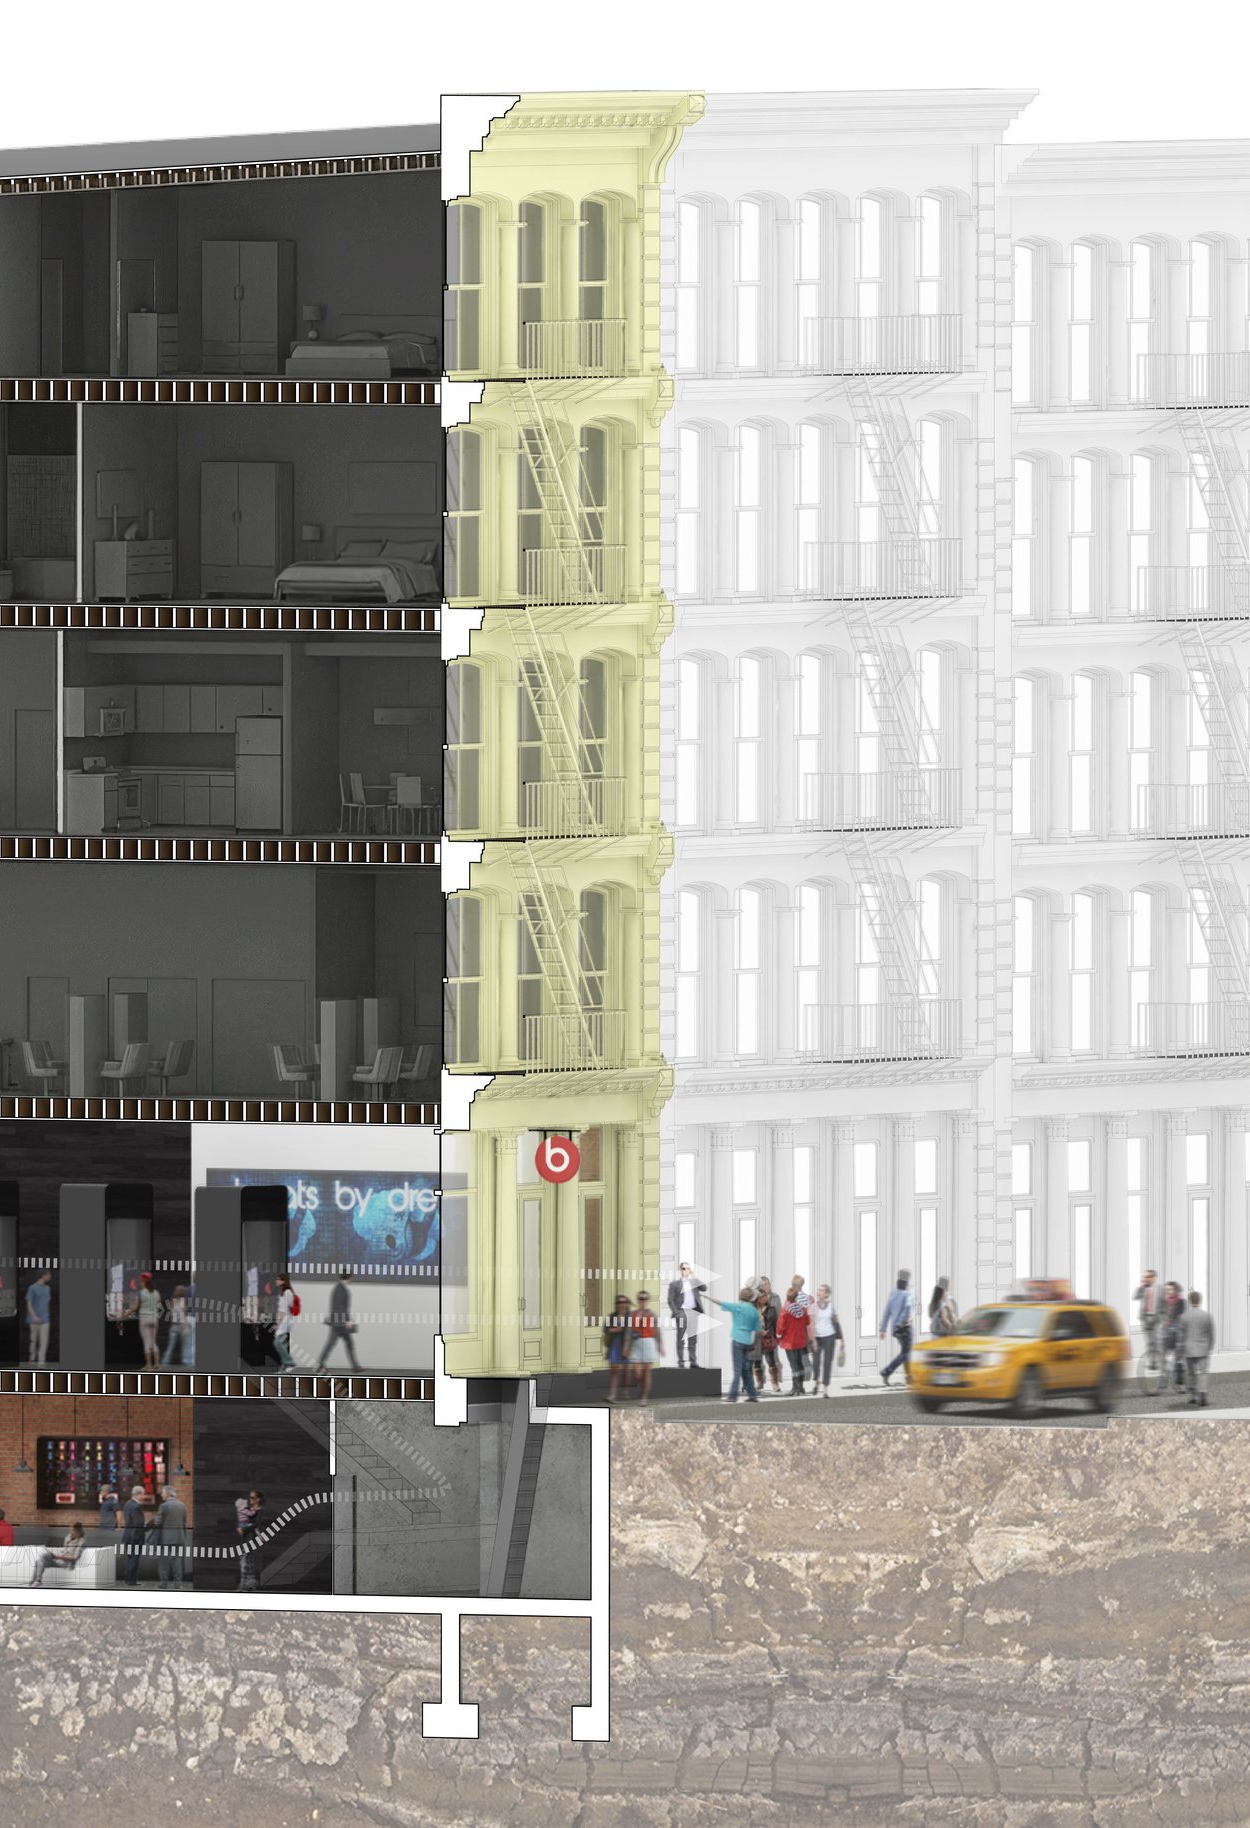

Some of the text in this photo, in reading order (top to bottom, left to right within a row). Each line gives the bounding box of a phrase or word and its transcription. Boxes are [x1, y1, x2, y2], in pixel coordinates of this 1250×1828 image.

[545, 1136, 570, 1173] b
[335, 1179, 374, 1218] by
[388, 1181, 438, 1213] dre
